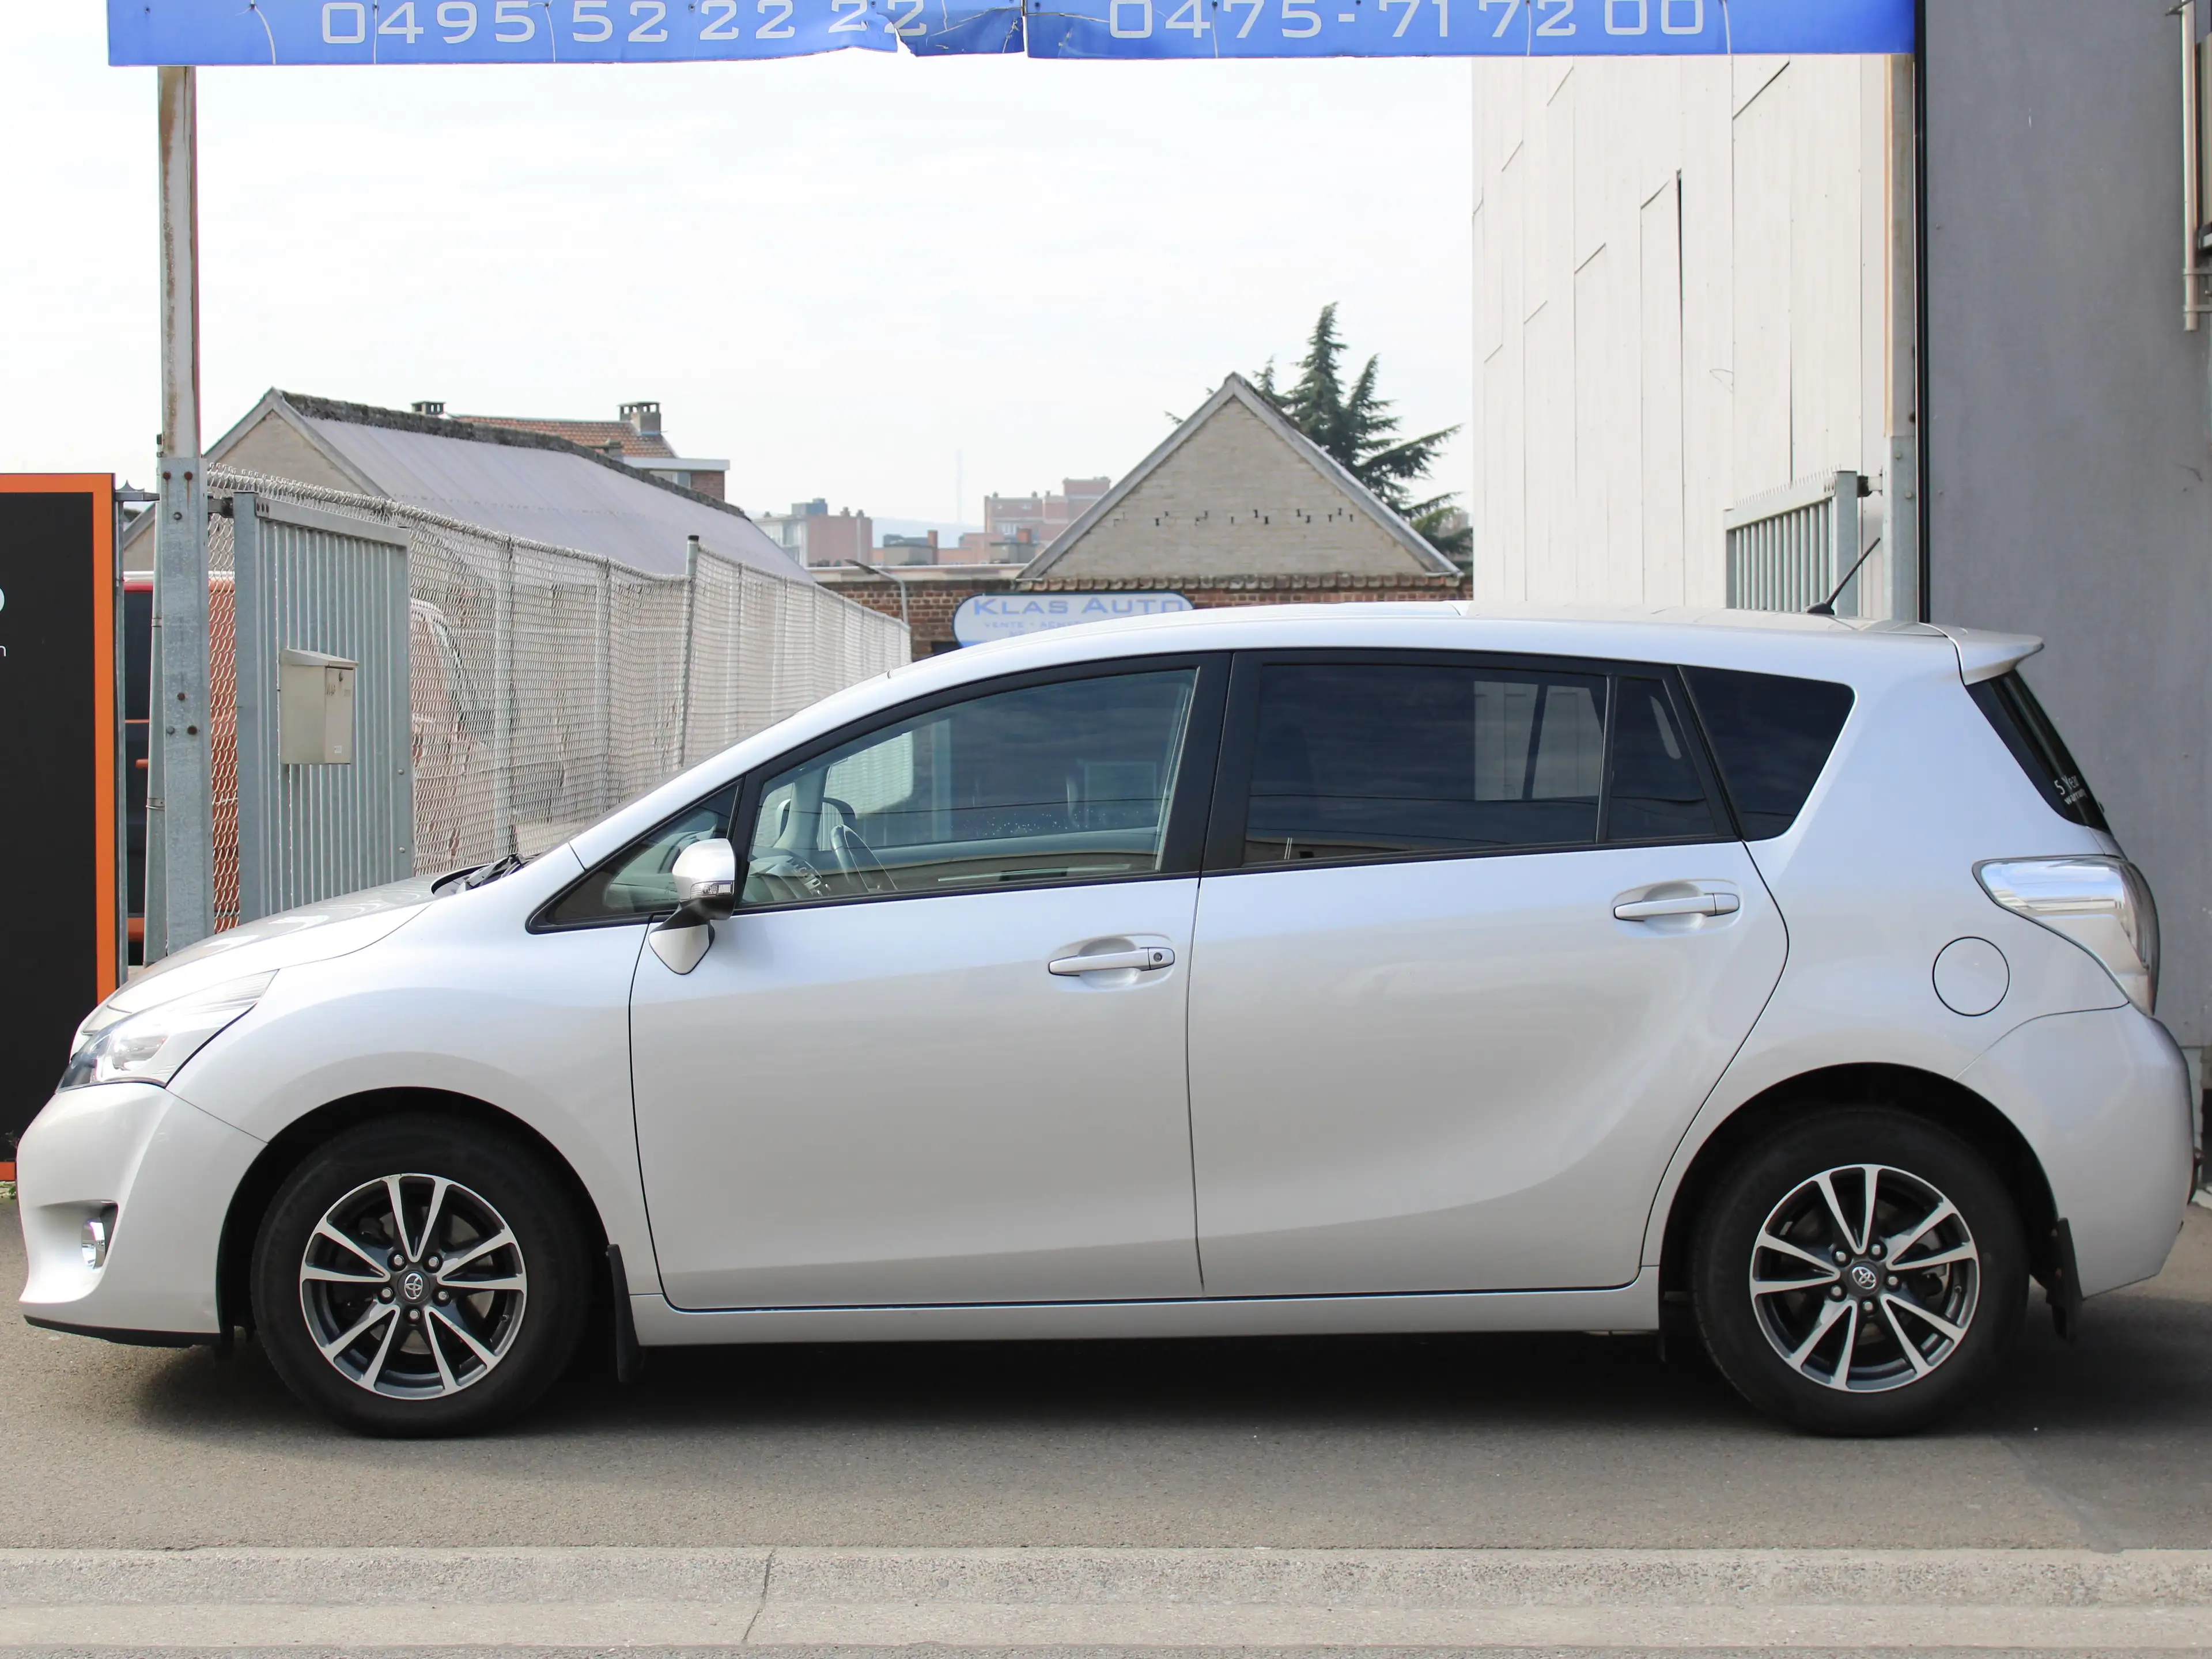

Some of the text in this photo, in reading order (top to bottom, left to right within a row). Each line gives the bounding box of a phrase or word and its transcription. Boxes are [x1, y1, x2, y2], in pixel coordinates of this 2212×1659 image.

[322, 0, 927, 44] 0495 52 22 22
[974, 596, 1183, 616] KLAS AUTO
[2054, 779, 2066, 796] 5
